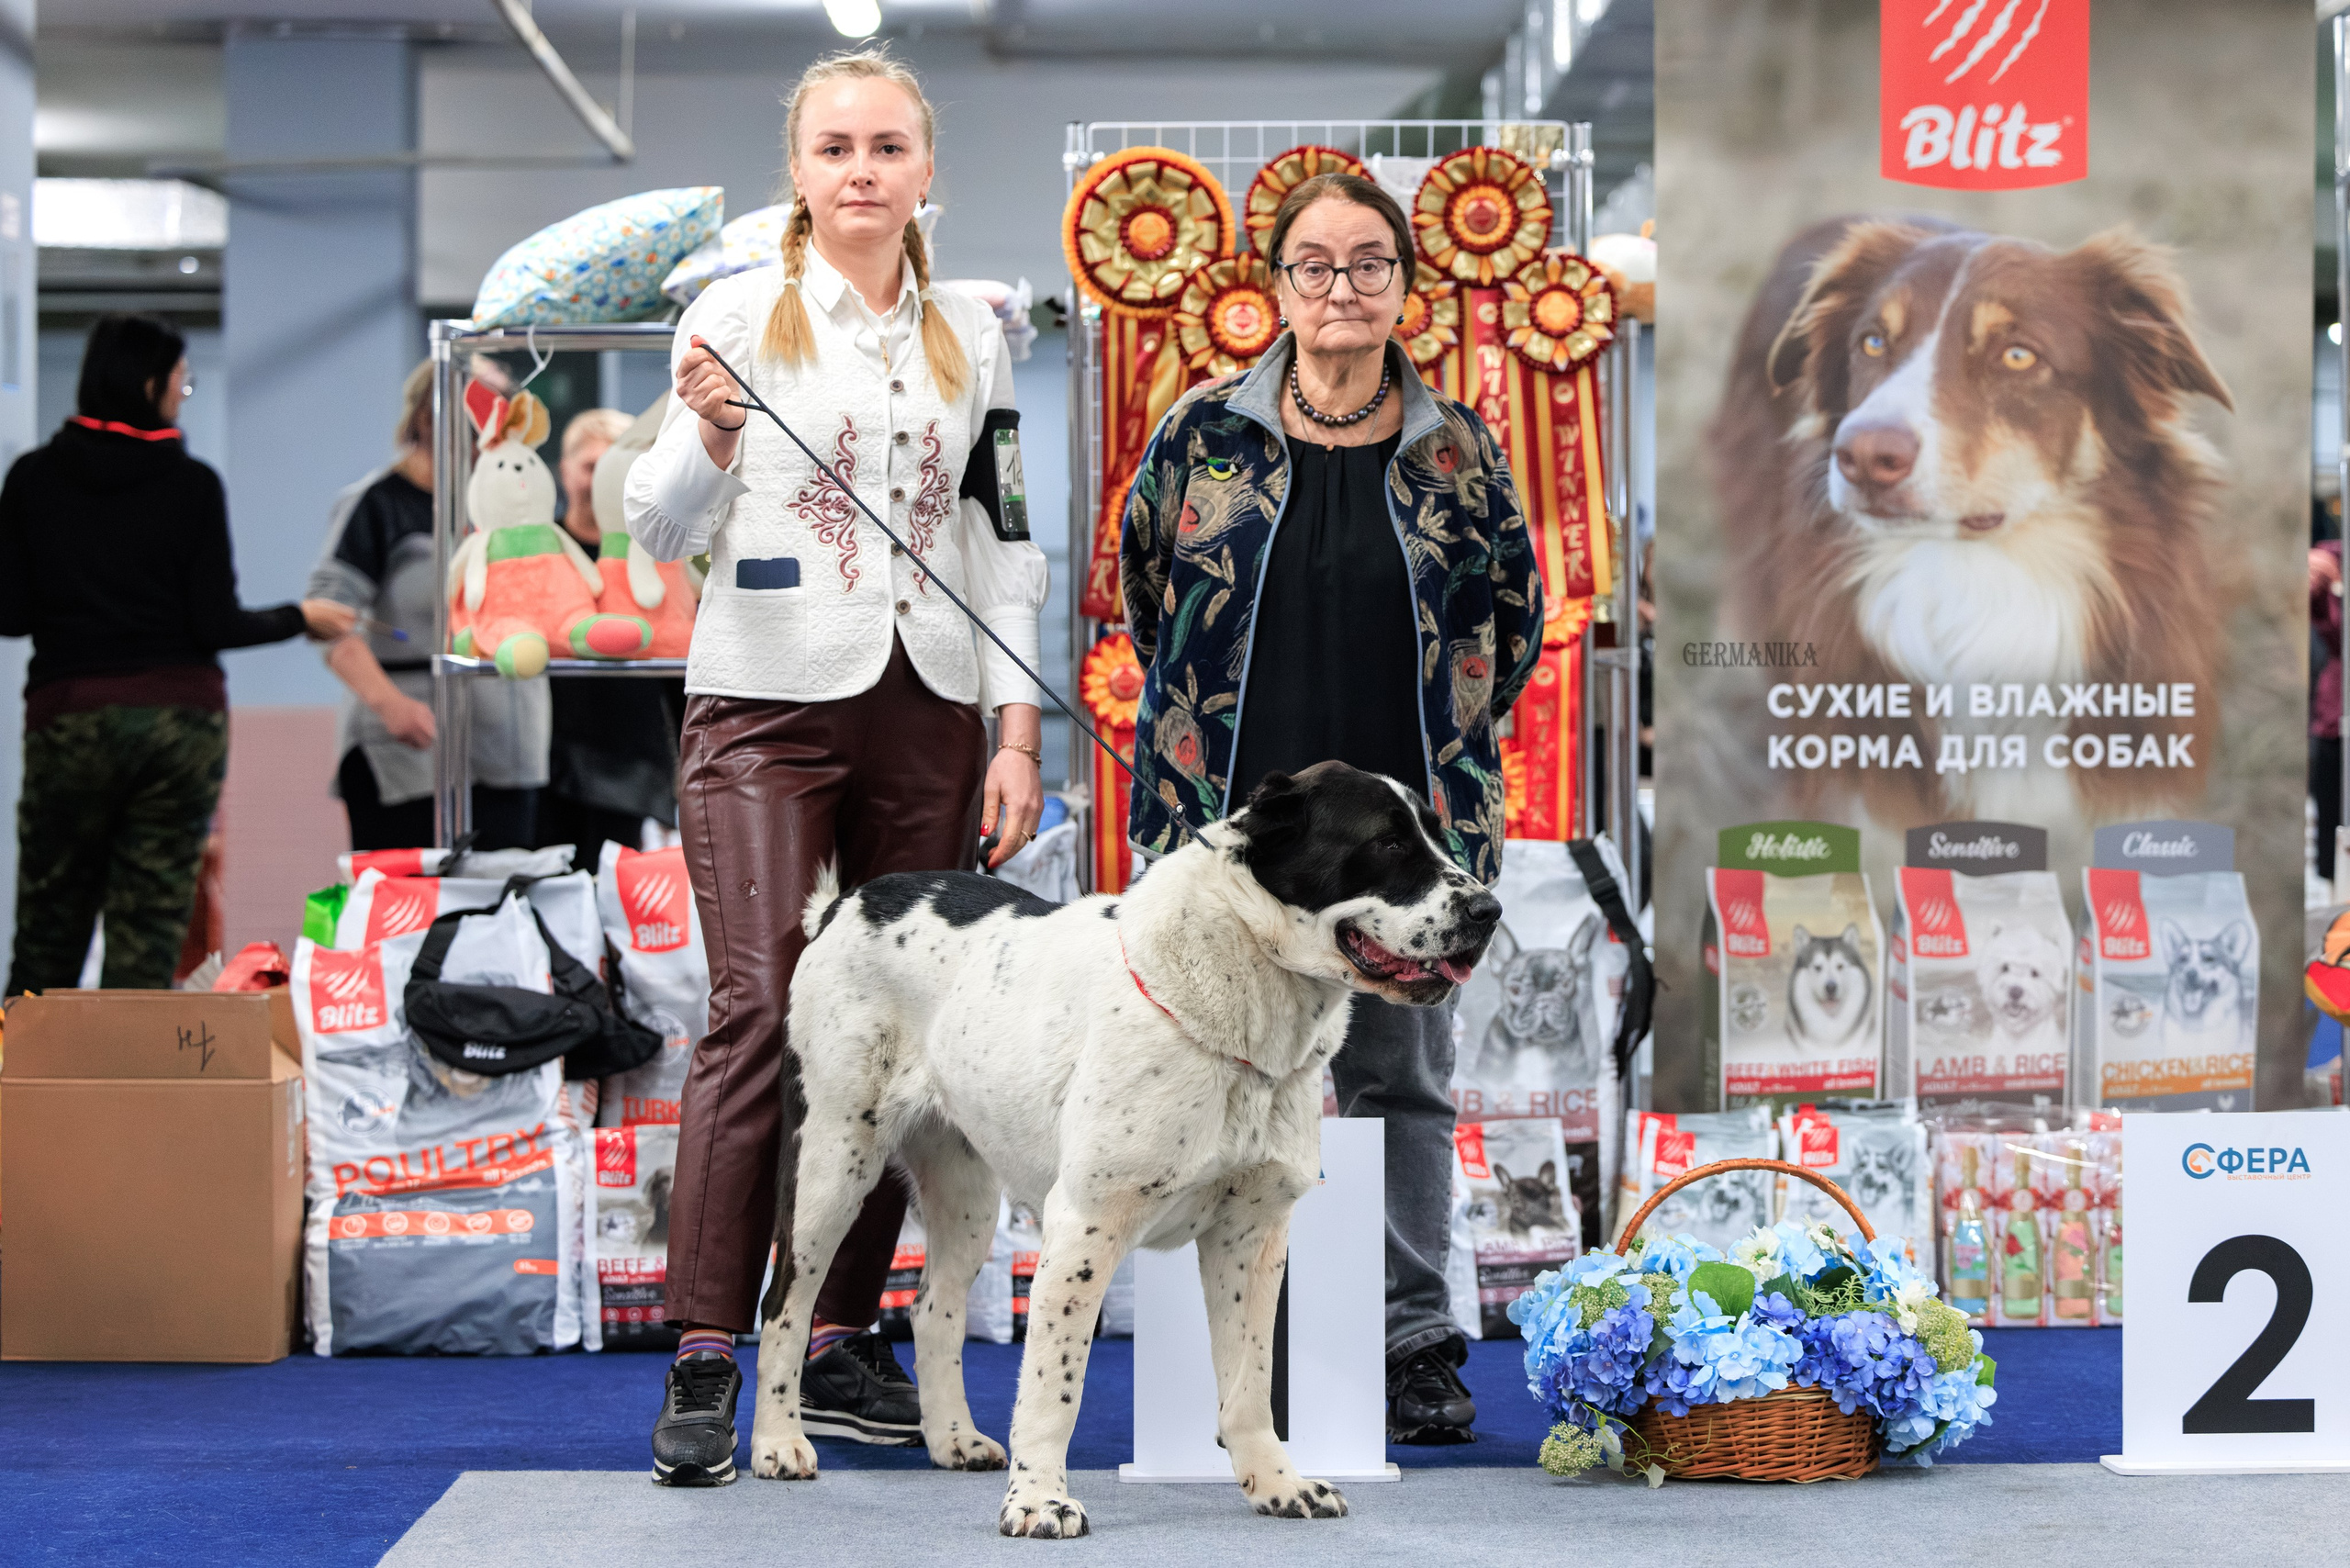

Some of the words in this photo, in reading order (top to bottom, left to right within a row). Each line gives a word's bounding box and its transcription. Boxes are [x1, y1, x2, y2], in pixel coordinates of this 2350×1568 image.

[1899, 102, 2065, 171] Blitz
[1767, 684, 1912, 718] СУХИЕ
[1926, 684, 1954, 717] И
[1968, 683, 2196, 718] ВЛАЖНЫЕ
[1768, 735, 1923, 768] КОРМА
[1935, 734, 2028, 774] ДЛЯ
[2042, 734, 2196, 768] СОБАК
[1745, 832, 1832, 860] Holistic
[1928, 832, 2020, 860] Sensitive
[2121, 832, 2199, 860] Classic
[635, 922, 682, 948] Blitz
[318, 1002, 380, 1030] Blitz
[1916, 1056, 1986, 1078] LAMB
[2015, 1052, 2068, 1075] RICE
[622, 1096, 681, 1121] TURK
[333, 1123, 546, 1199] POULTRY
[2182, 1143, 2311, 1180] СФЕРА
[2287, 1173, 2312, 1182] ЦЕНТР
[598, 1258, 647, 1274] BEEF
[2182, 1234, 2315, 1434] 2
